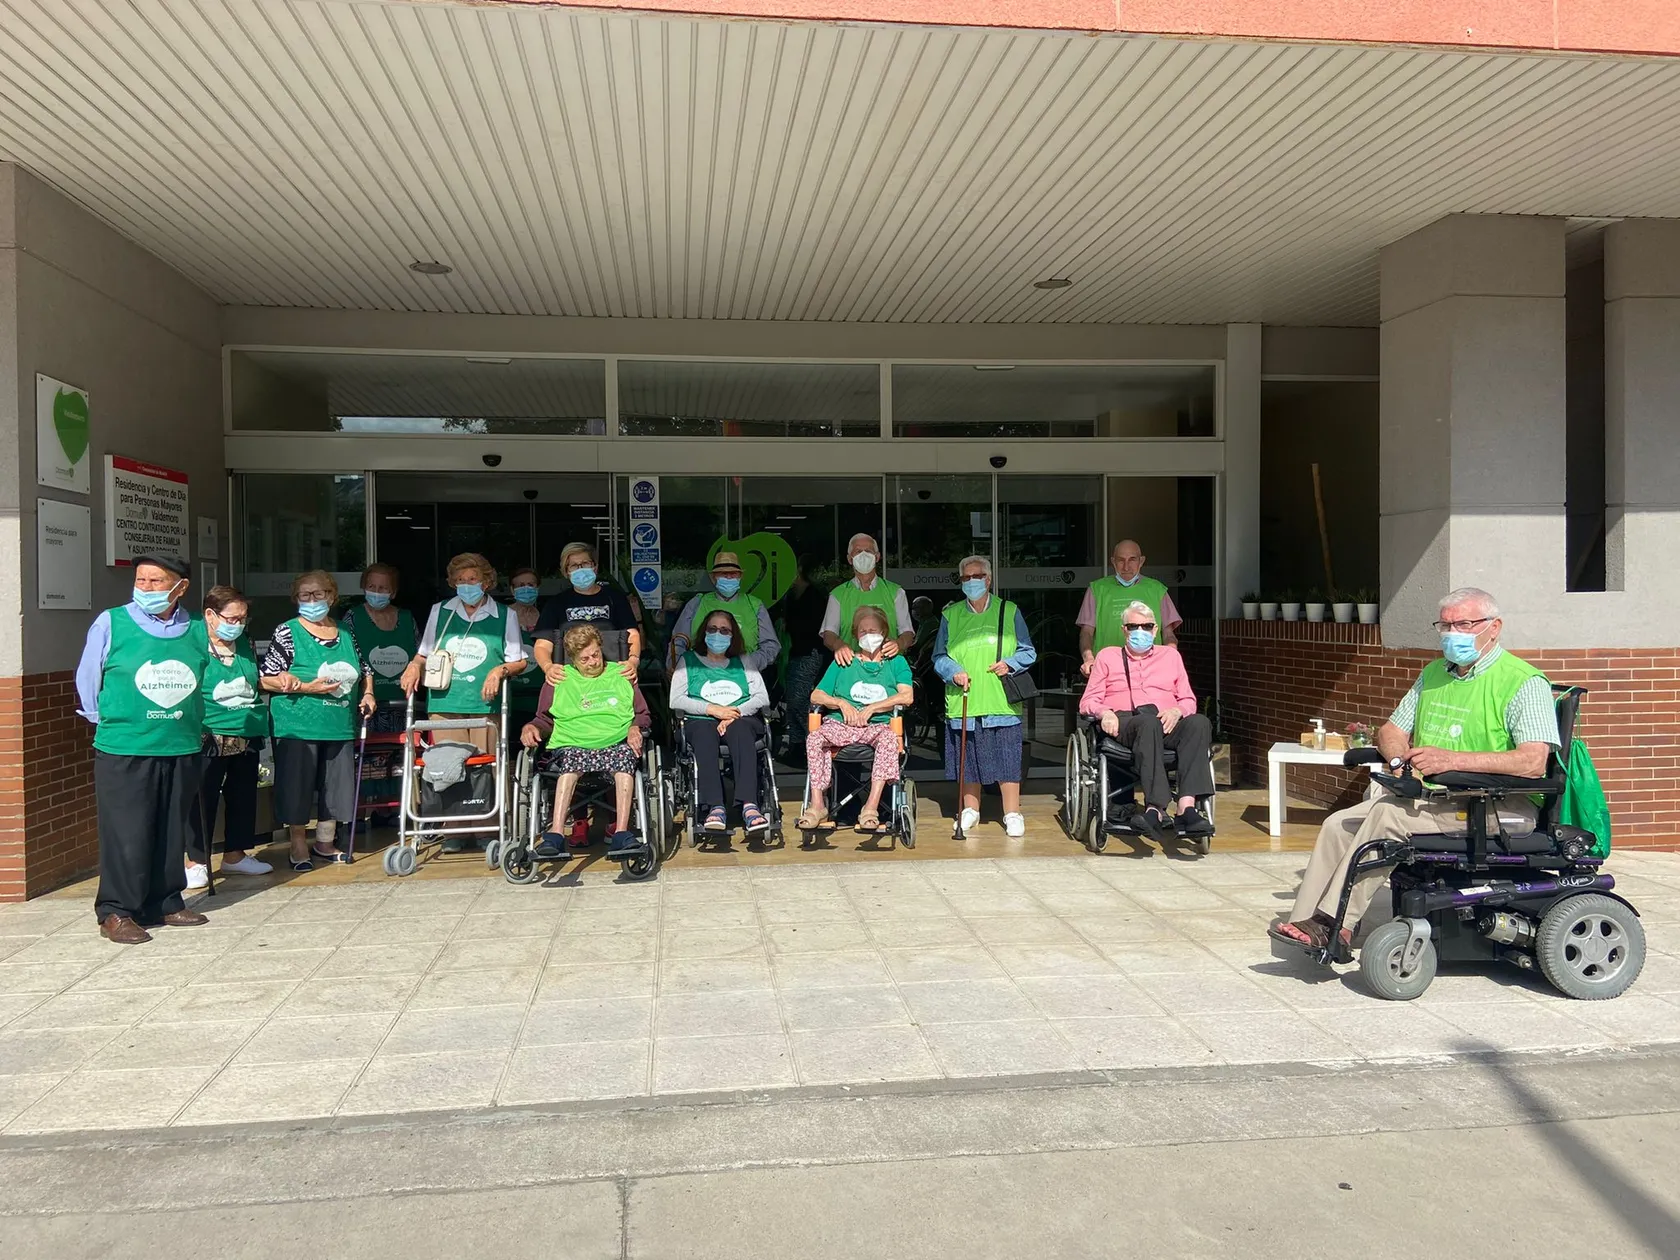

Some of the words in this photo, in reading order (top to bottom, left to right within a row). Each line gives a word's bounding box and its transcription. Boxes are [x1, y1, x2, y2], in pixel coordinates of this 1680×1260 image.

[115, 476, 146, 493] Residencia
[147, 486, 151, 496] y
[152, 484, 170, 497] Centro
[170, 489, 177, 499] de
[120, 494, 134, 504] para
[134, 494, 160, 508] Personas
[161, 499, 183, 512] Mayores
[151, 510, 179, 523] Valdemoro
[45, 525, 68, 536] Residencia
[116, 518, 137, 530] CENTRO
[138, 522, 170, 534] CONTRATADO
[170, 526, 180, 535] POR
[180, 527, 187, 536] LA
[155, 535, 162, 544] DE
[163, 536, 181, 545] FAMILIA
[913, 574, 950, 584] Domus
[1025, 574, 1061, 583] Domus
